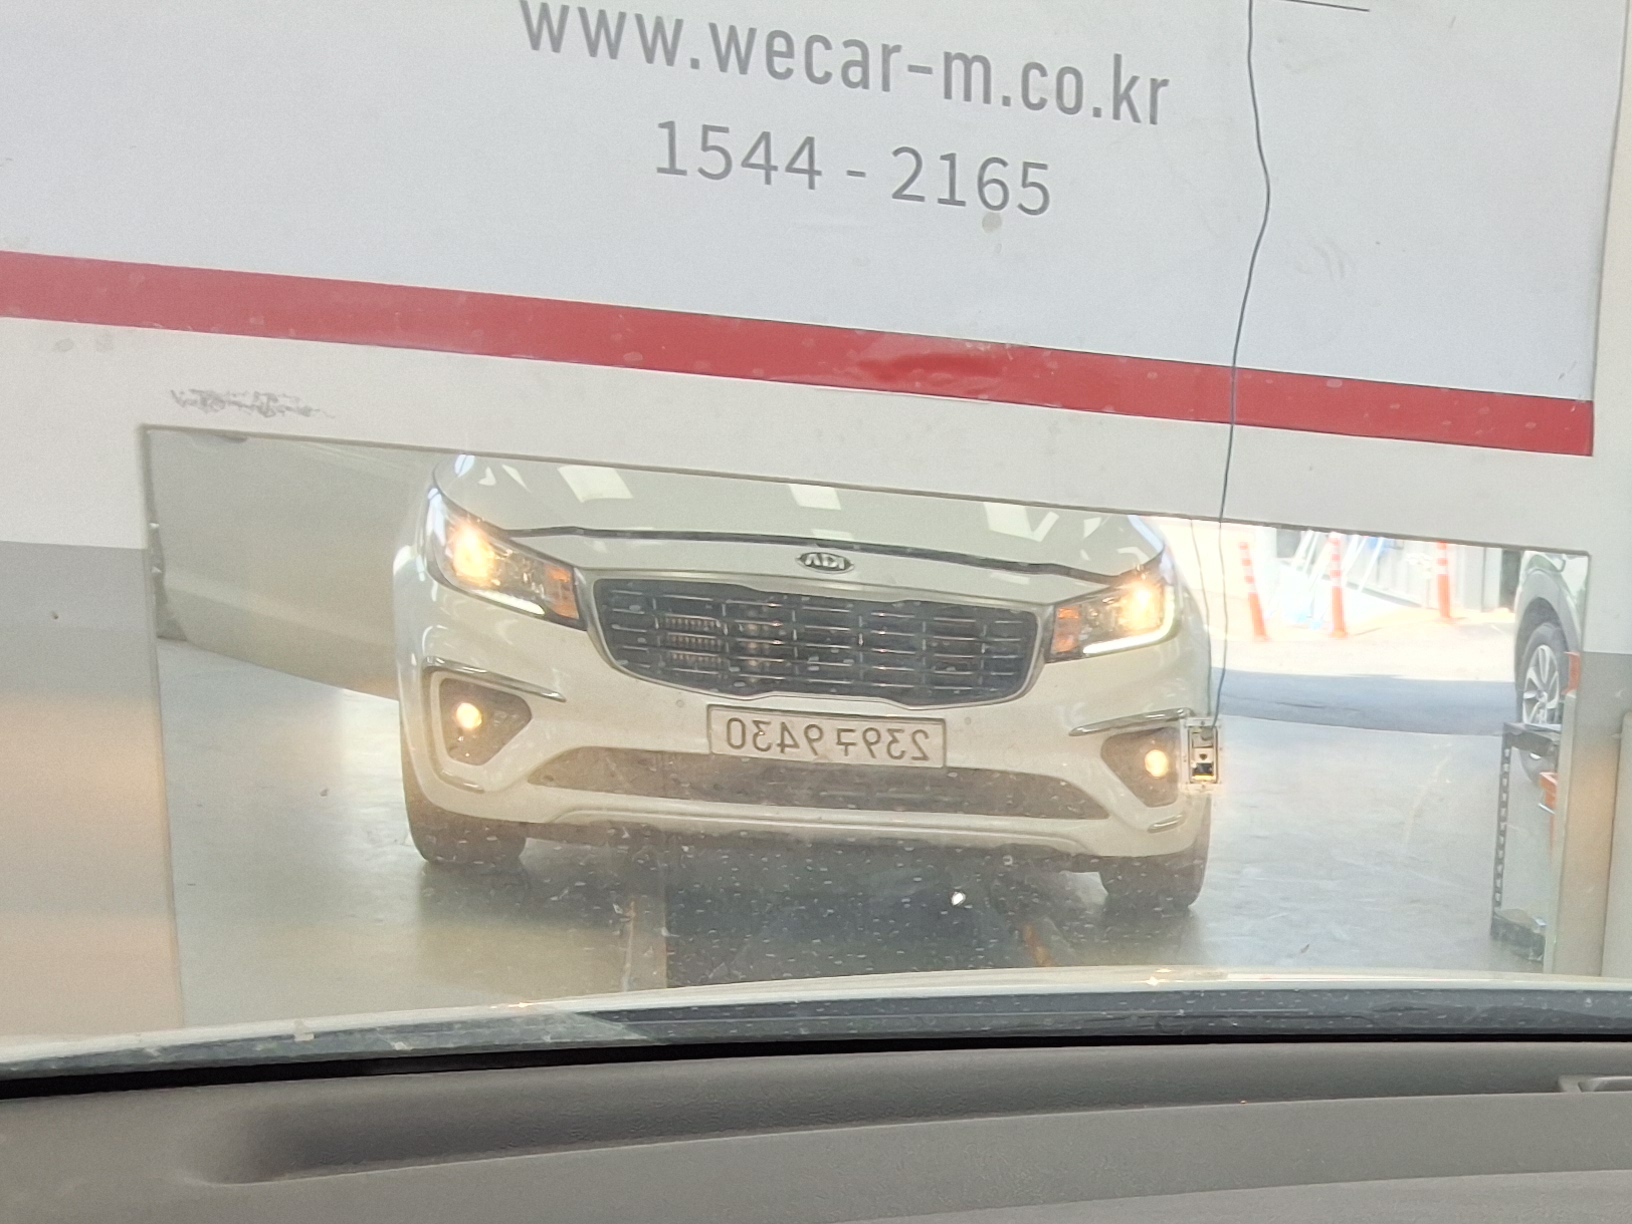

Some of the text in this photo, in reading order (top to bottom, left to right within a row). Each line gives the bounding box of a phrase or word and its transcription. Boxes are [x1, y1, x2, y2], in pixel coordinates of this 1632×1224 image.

[519, 0, 1170, 125] www.wecar-m.co.kr
[655, 119, 823, 191] 1544
[890, 145, 1052, 216] 2165
